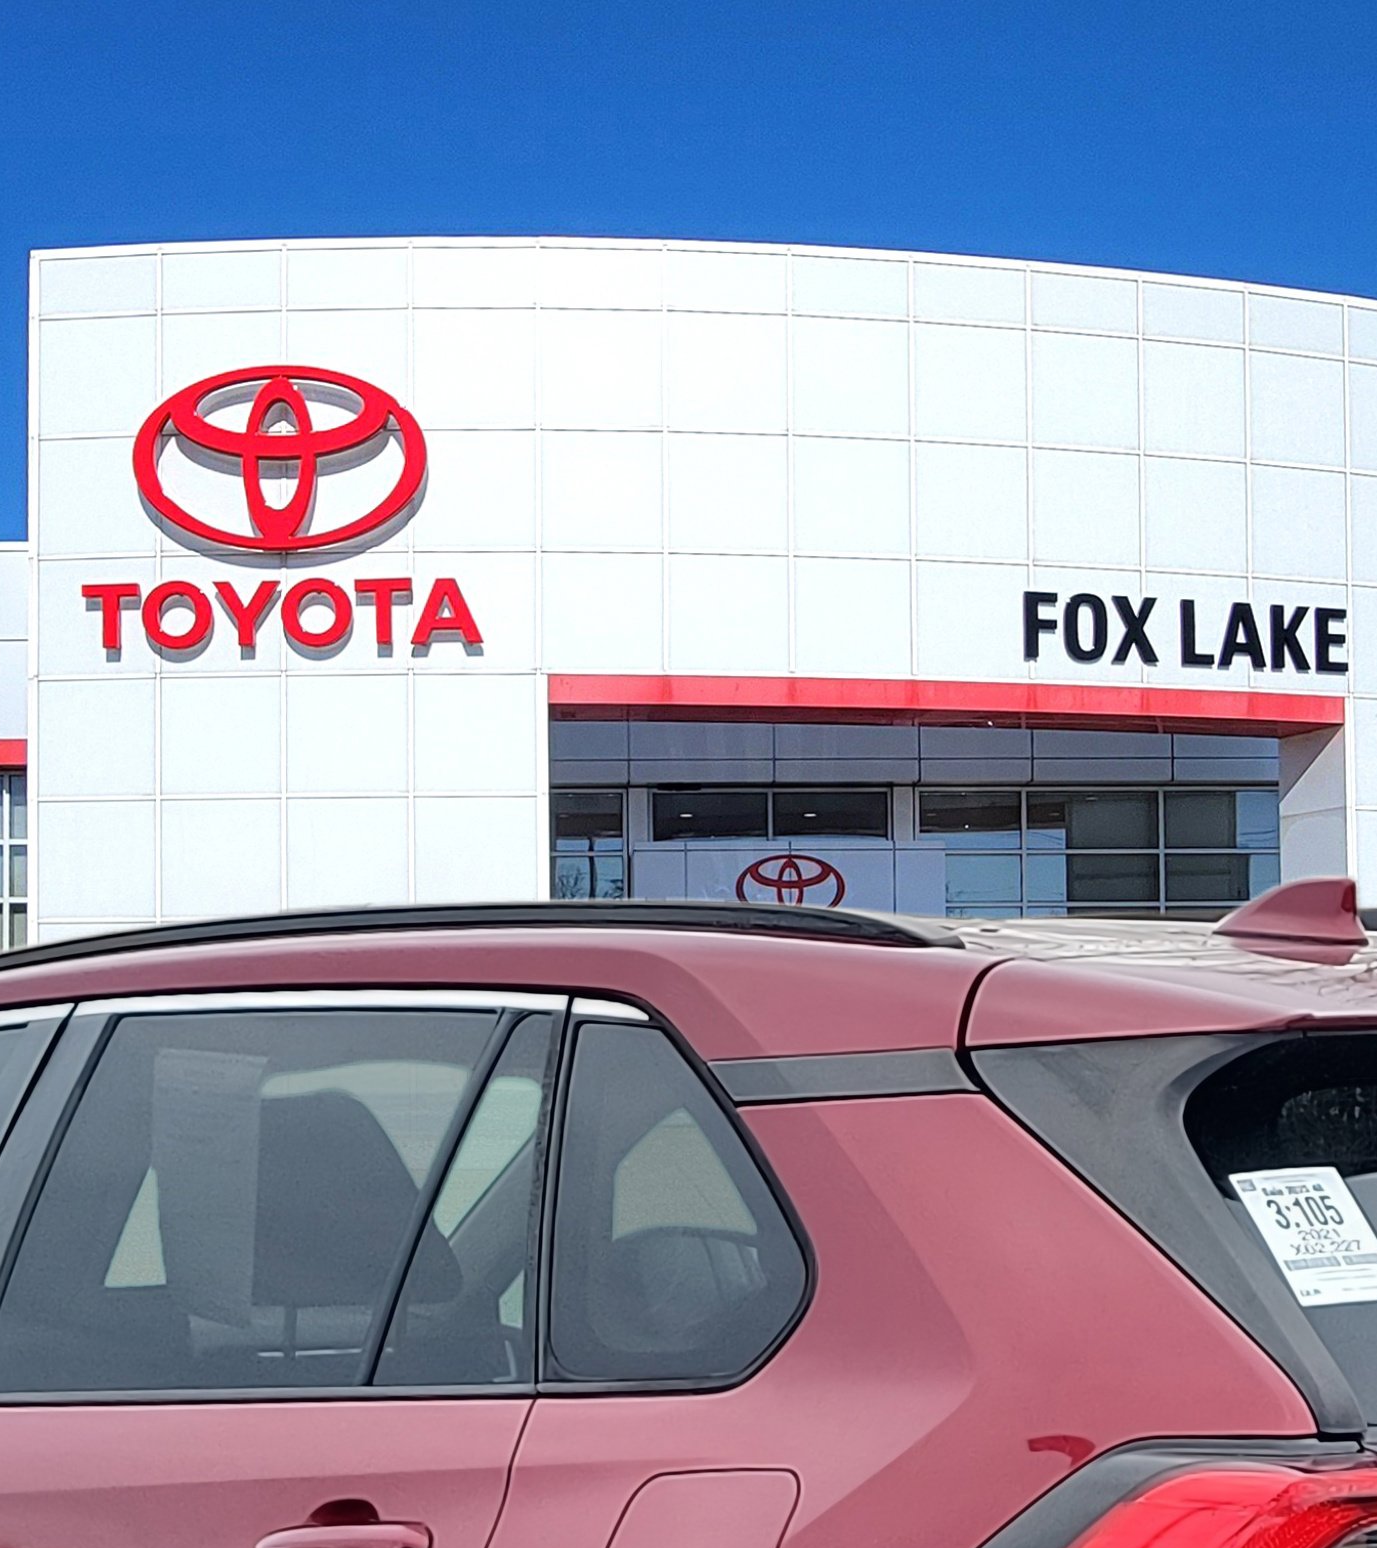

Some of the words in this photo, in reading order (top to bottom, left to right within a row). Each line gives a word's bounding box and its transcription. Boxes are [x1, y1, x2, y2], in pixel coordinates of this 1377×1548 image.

[81, 577, 484, 656] TOYOTA
[1022, 591, 1160, 665] FOX
[1179, 598, 1349, 674] LAKE
[1266, 1195, 1344, 1230] 3:105
